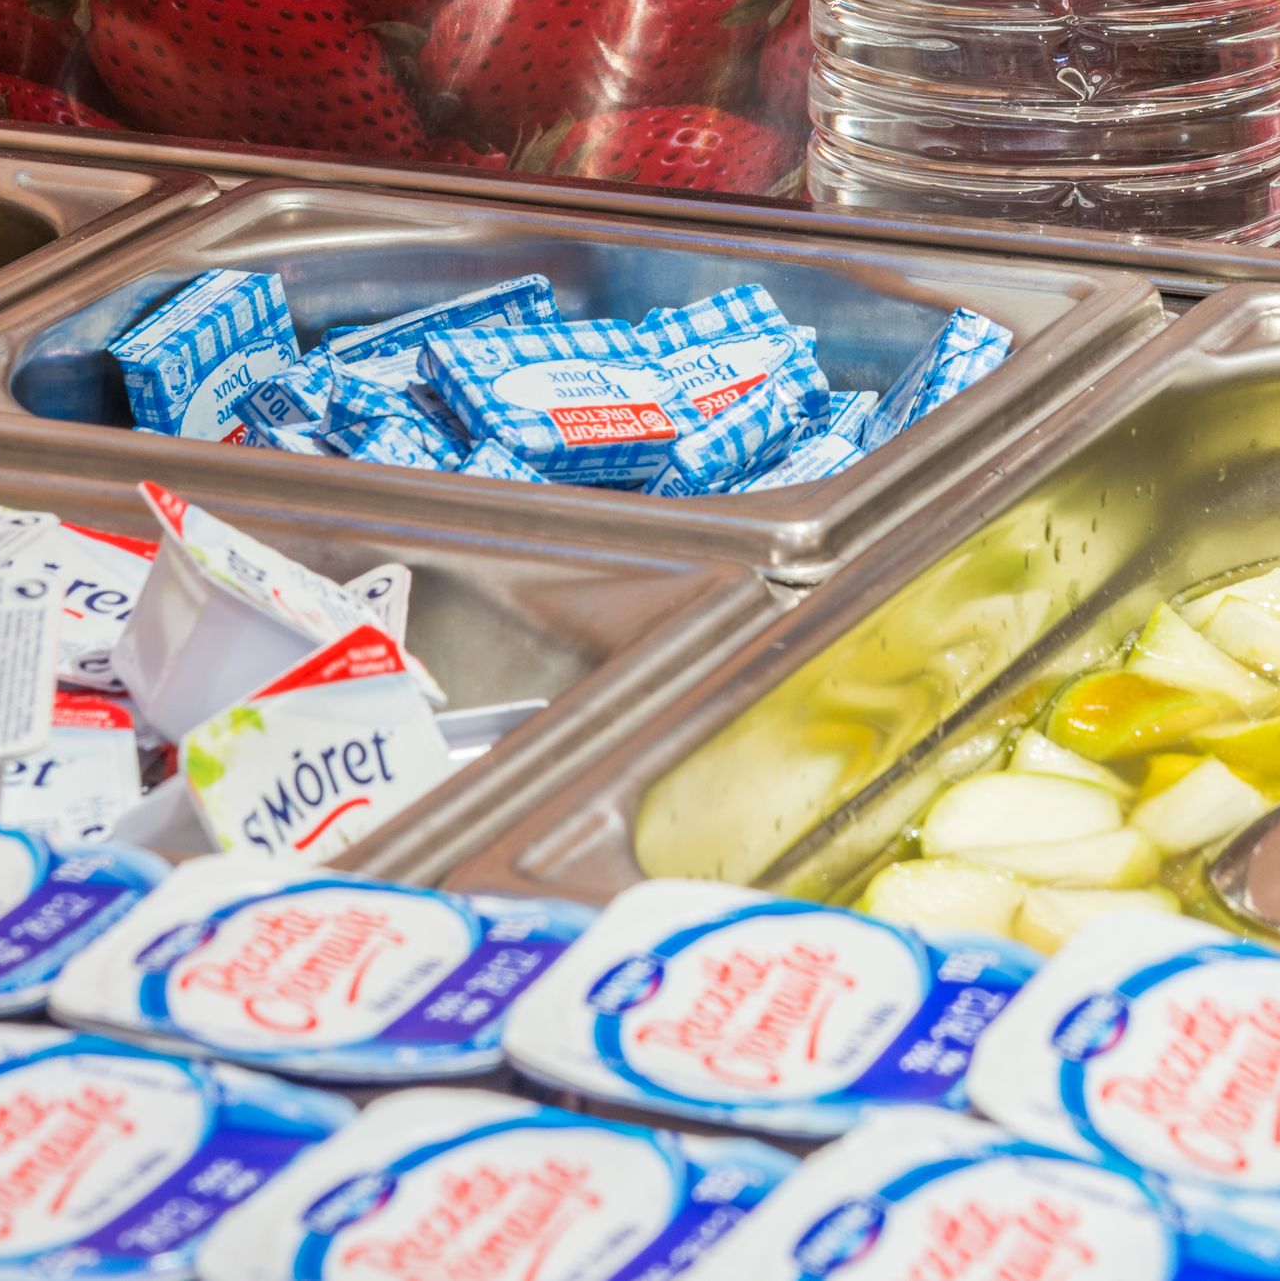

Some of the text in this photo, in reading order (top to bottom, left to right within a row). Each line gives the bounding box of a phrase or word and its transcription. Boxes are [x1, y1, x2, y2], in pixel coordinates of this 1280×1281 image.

[548, 369, 611, 385] Doux
[667, 353, 721, 378] Dou
[681, 364, 740, 391] Beur
[213, 363, 253, 403] Doux
[554, 383, 631, 399] Beurre
[695, 388, 741, 418] BRE
